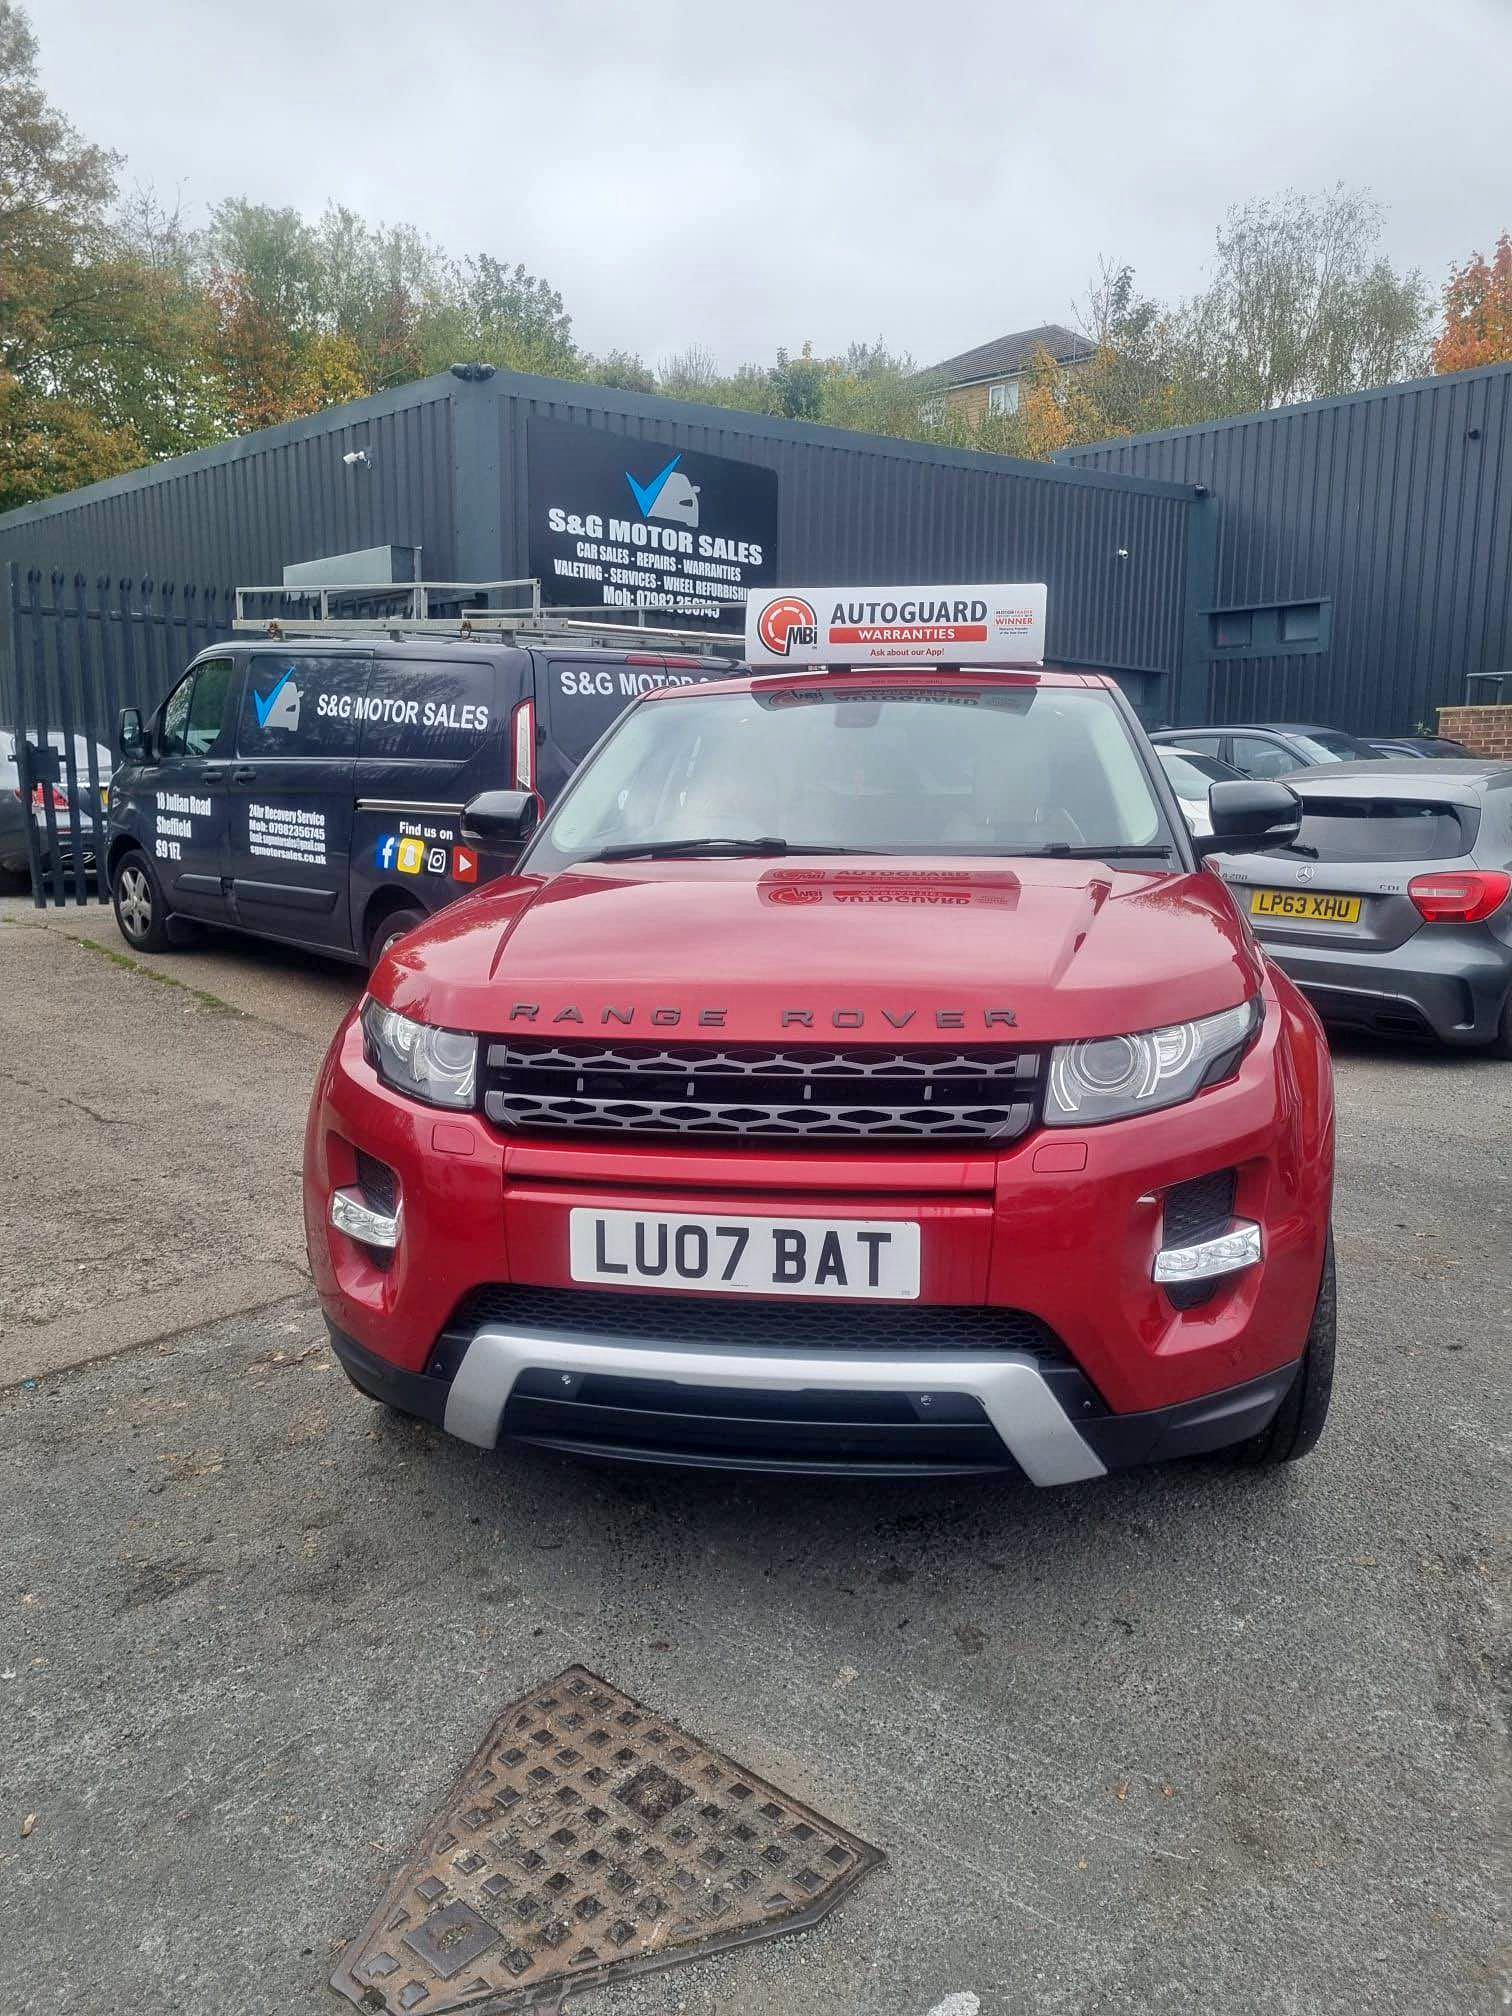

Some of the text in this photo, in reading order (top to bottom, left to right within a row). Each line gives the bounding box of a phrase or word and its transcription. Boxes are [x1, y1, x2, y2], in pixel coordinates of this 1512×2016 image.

[548, 507, 763, 565] S&G MOTOR SALES
[576, 541, 598, 560] CAR
[599, 545, 629, 565] SALES
[636, 551, 677, 572] REPAIRS
[683, 558, 741, 582] WARRANTIES
[553, 558, 602, 581] VALETING
[610, 567, 656, 589] SERVICES
[663, 575, 694, 594] WHEEL
[696, 580, 749, 601] REFURBISHI
[603, 585, 634, 607] Mob:
[830, 600, 988, 625] AUTOGUARD
[995, 617, 1033, 625] WINNER
[858, 628, 955, 641] WARRANTIES
[870, 648, 885, 656] Ask
[887, 648, 909, 656] about
[926, 648, 945, 657] App!
[560, 671, 613, 696] S&G
[317, 694, 489, 730] S&G MOTOR SALES
[156, 791, 211, 816] 18 Julian Road
[249, 803, 325, 826] 24hr Recovery Service
[156, 815, 192, 838] Sheffield
[399, 821, 453, 841] Find us on
[155, 839, 168, 858] S9
[1259, 893, 1350, 918] LP63 XHU
[508, 1002, 1018, 1029] RANGE ROVER
[595, 1219, 892, 1288] LU07 BAT
